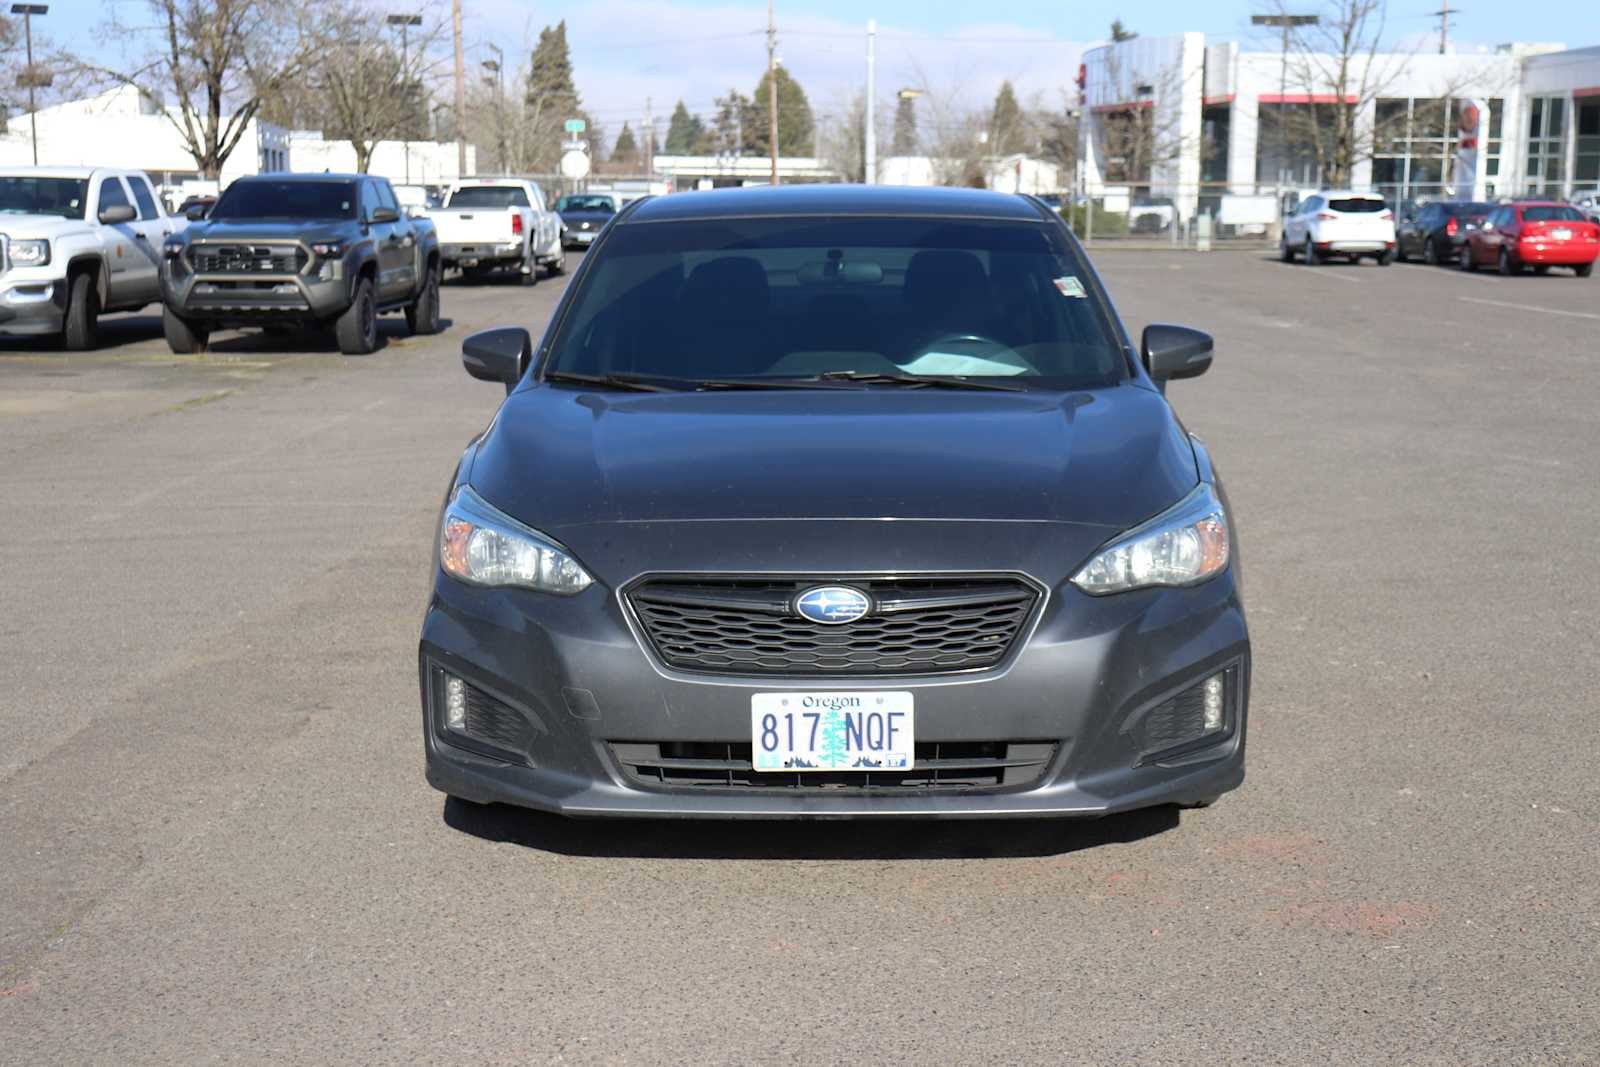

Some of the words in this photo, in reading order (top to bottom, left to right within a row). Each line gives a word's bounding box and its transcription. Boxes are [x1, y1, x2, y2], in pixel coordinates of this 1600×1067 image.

[802, 695, 860, 711] Oregon
[761, 712, 821, 752] 817
[845, 712, 905, 751] NQF
